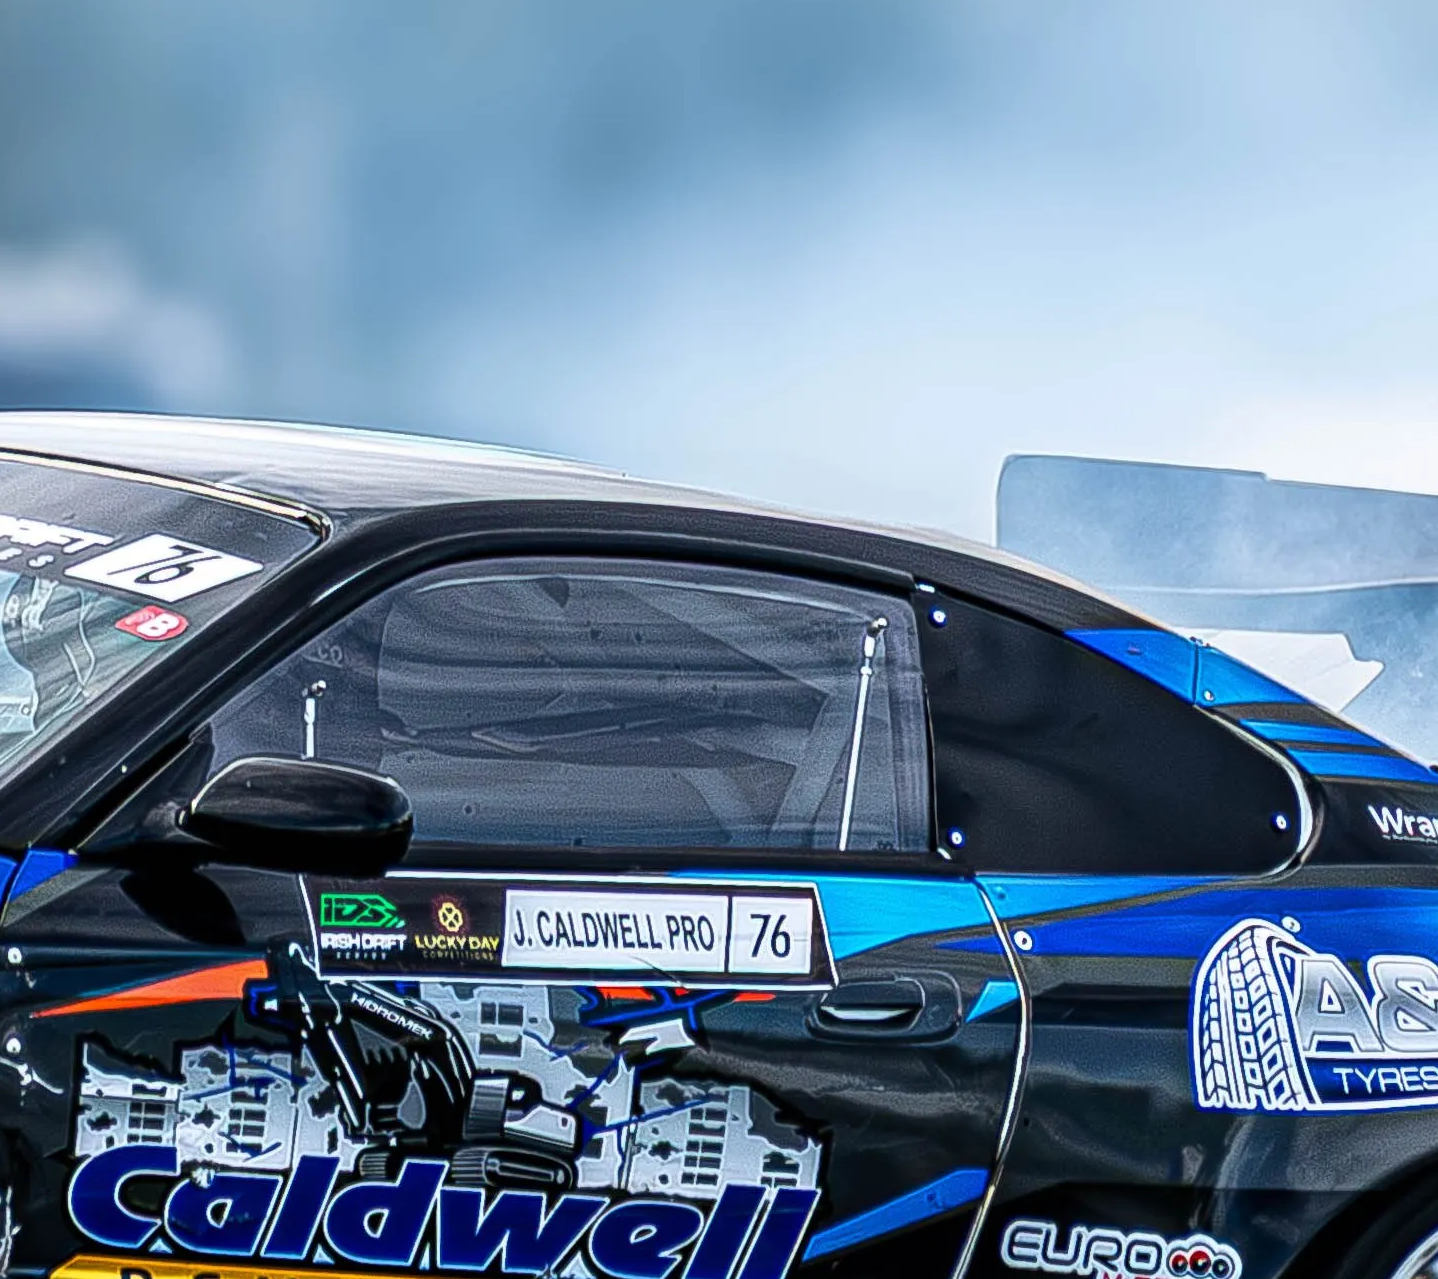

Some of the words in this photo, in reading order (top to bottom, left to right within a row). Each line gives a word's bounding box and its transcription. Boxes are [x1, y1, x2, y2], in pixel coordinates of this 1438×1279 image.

[106, 544, 223, 584] 76
[362, 934, 407, 950] DRIFT
[414, 935, 466, 949] LUCKY
[469, 936, 500, 951] DAY
[513, 909, 533, 946] J.
[539, 910, 663, 950] CALDWELL
[669, 915, 716, 952] PRO
[750, 913, 791, 959] 76
[351, 992, 433, 1040] HIDROMEK
[1006, 1224, 1164, 1275] EURO
